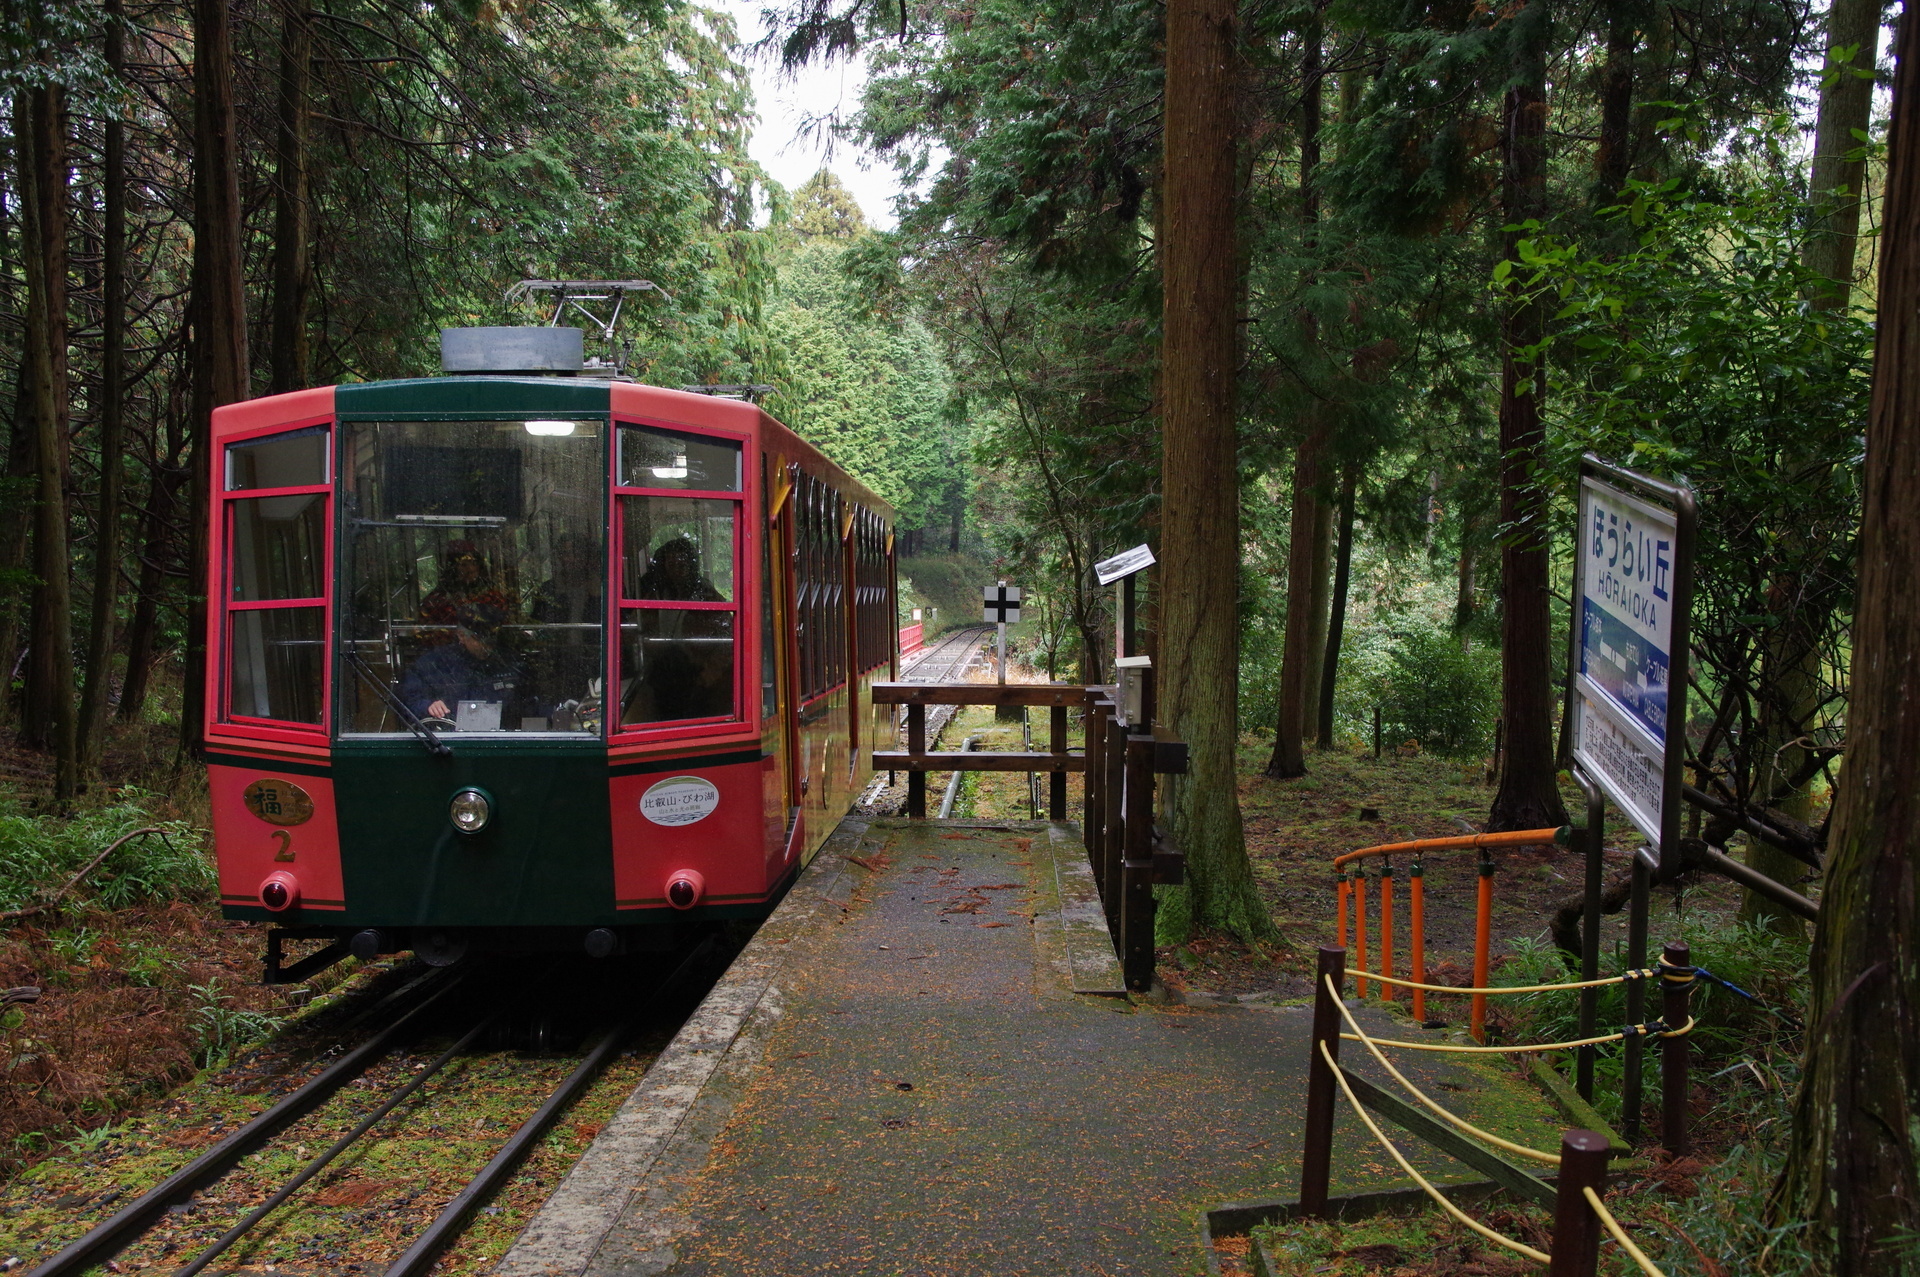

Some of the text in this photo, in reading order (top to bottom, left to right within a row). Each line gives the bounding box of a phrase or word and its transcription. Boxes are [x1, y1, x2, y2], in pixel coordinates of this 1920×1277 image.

[1592, 505, 1669, 602] ほうらい丘
[253, 786, 282, 815] 福
[644, 791, 715, 809] 比叡山・びわ湖
[270, 829, 296, 863] 2
